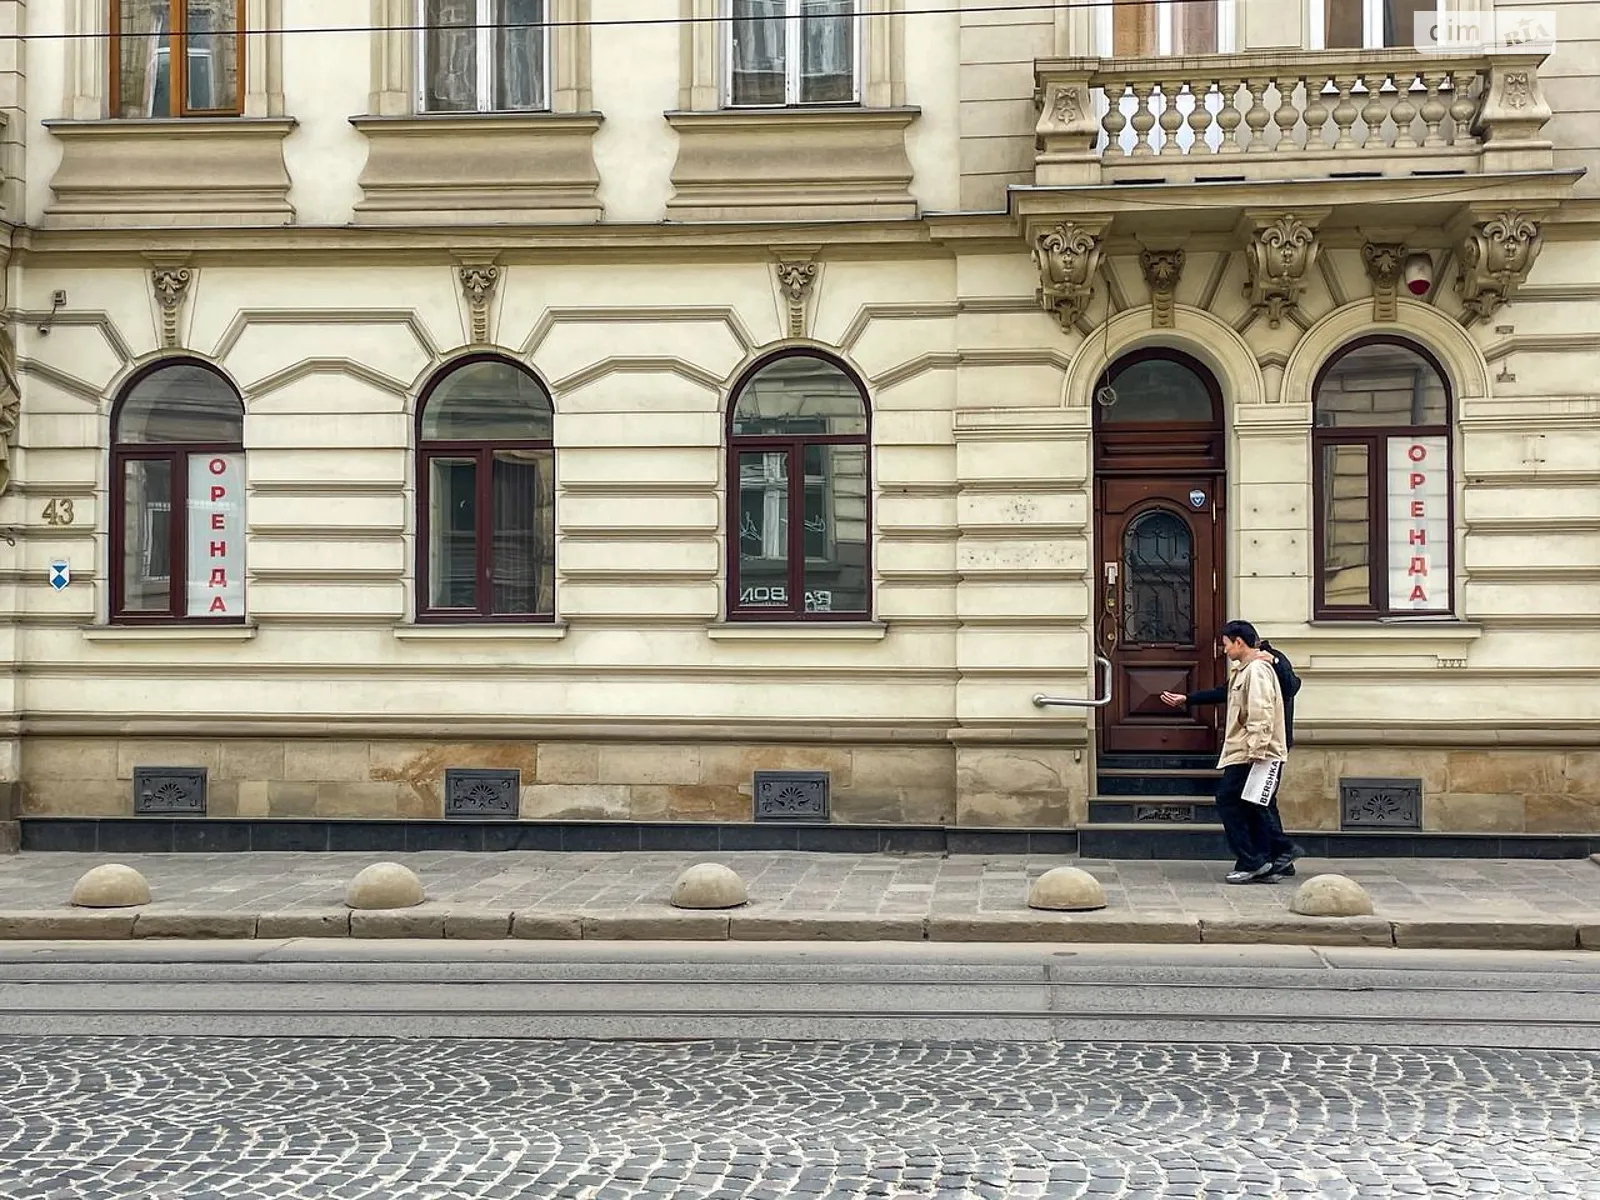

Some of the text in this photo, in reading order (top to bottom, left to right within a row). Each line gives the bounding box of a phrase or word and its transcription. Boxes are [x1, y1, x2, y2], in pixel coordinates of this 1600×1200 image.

[42, 499, 74, 525] 43
[209, 459, 226, 612] ОРЕНДА
[1408, 445, 1427, 601] ОРЕНДА
[1260, 760, 1279, 804] BERSHKA
